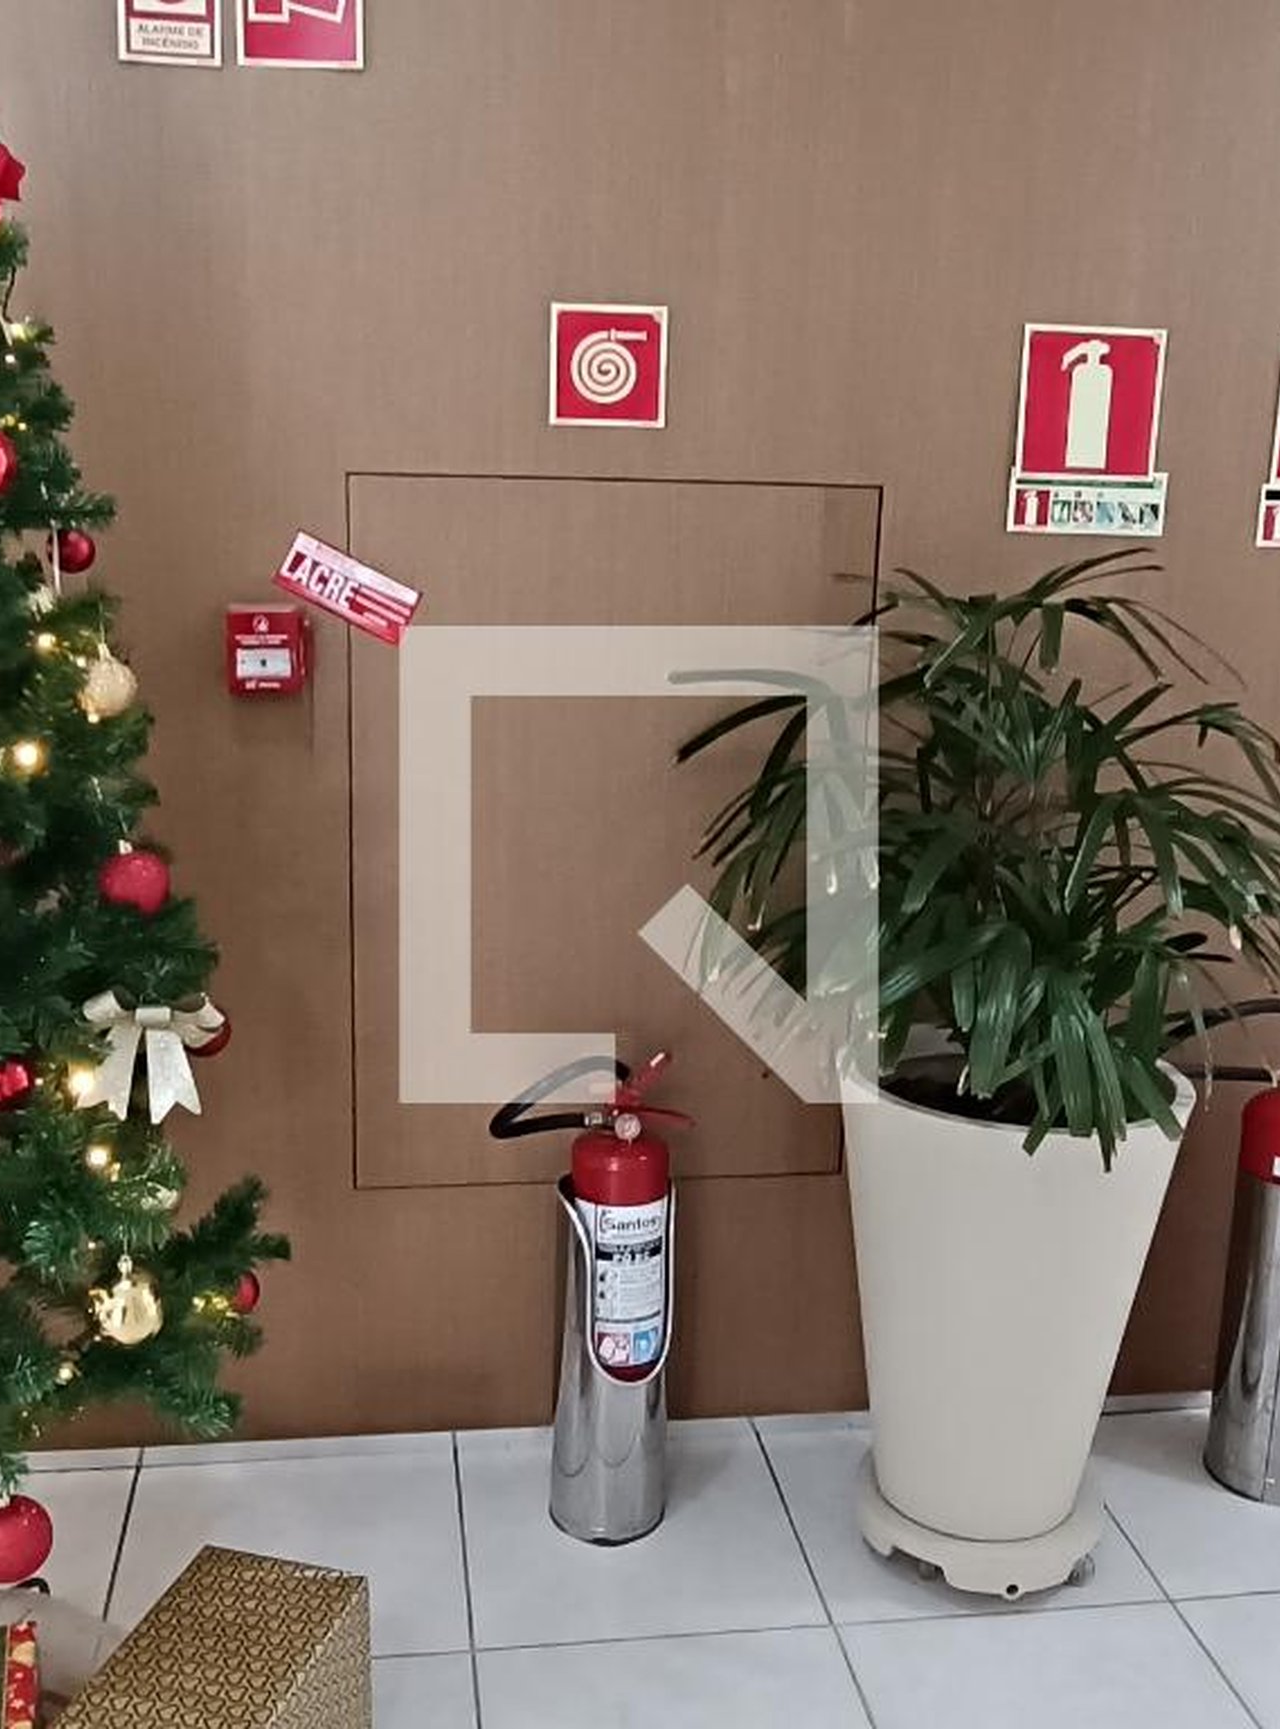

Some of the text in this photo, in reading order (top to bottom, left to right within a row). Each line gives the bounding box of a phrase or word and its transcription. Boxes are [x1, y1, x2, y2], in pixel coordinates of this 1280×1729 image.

[137, 24, 205, 37] ALARME DE
[279, 550, 360, 608] LACRE
[603, 1216, 657, 1231] Santos
